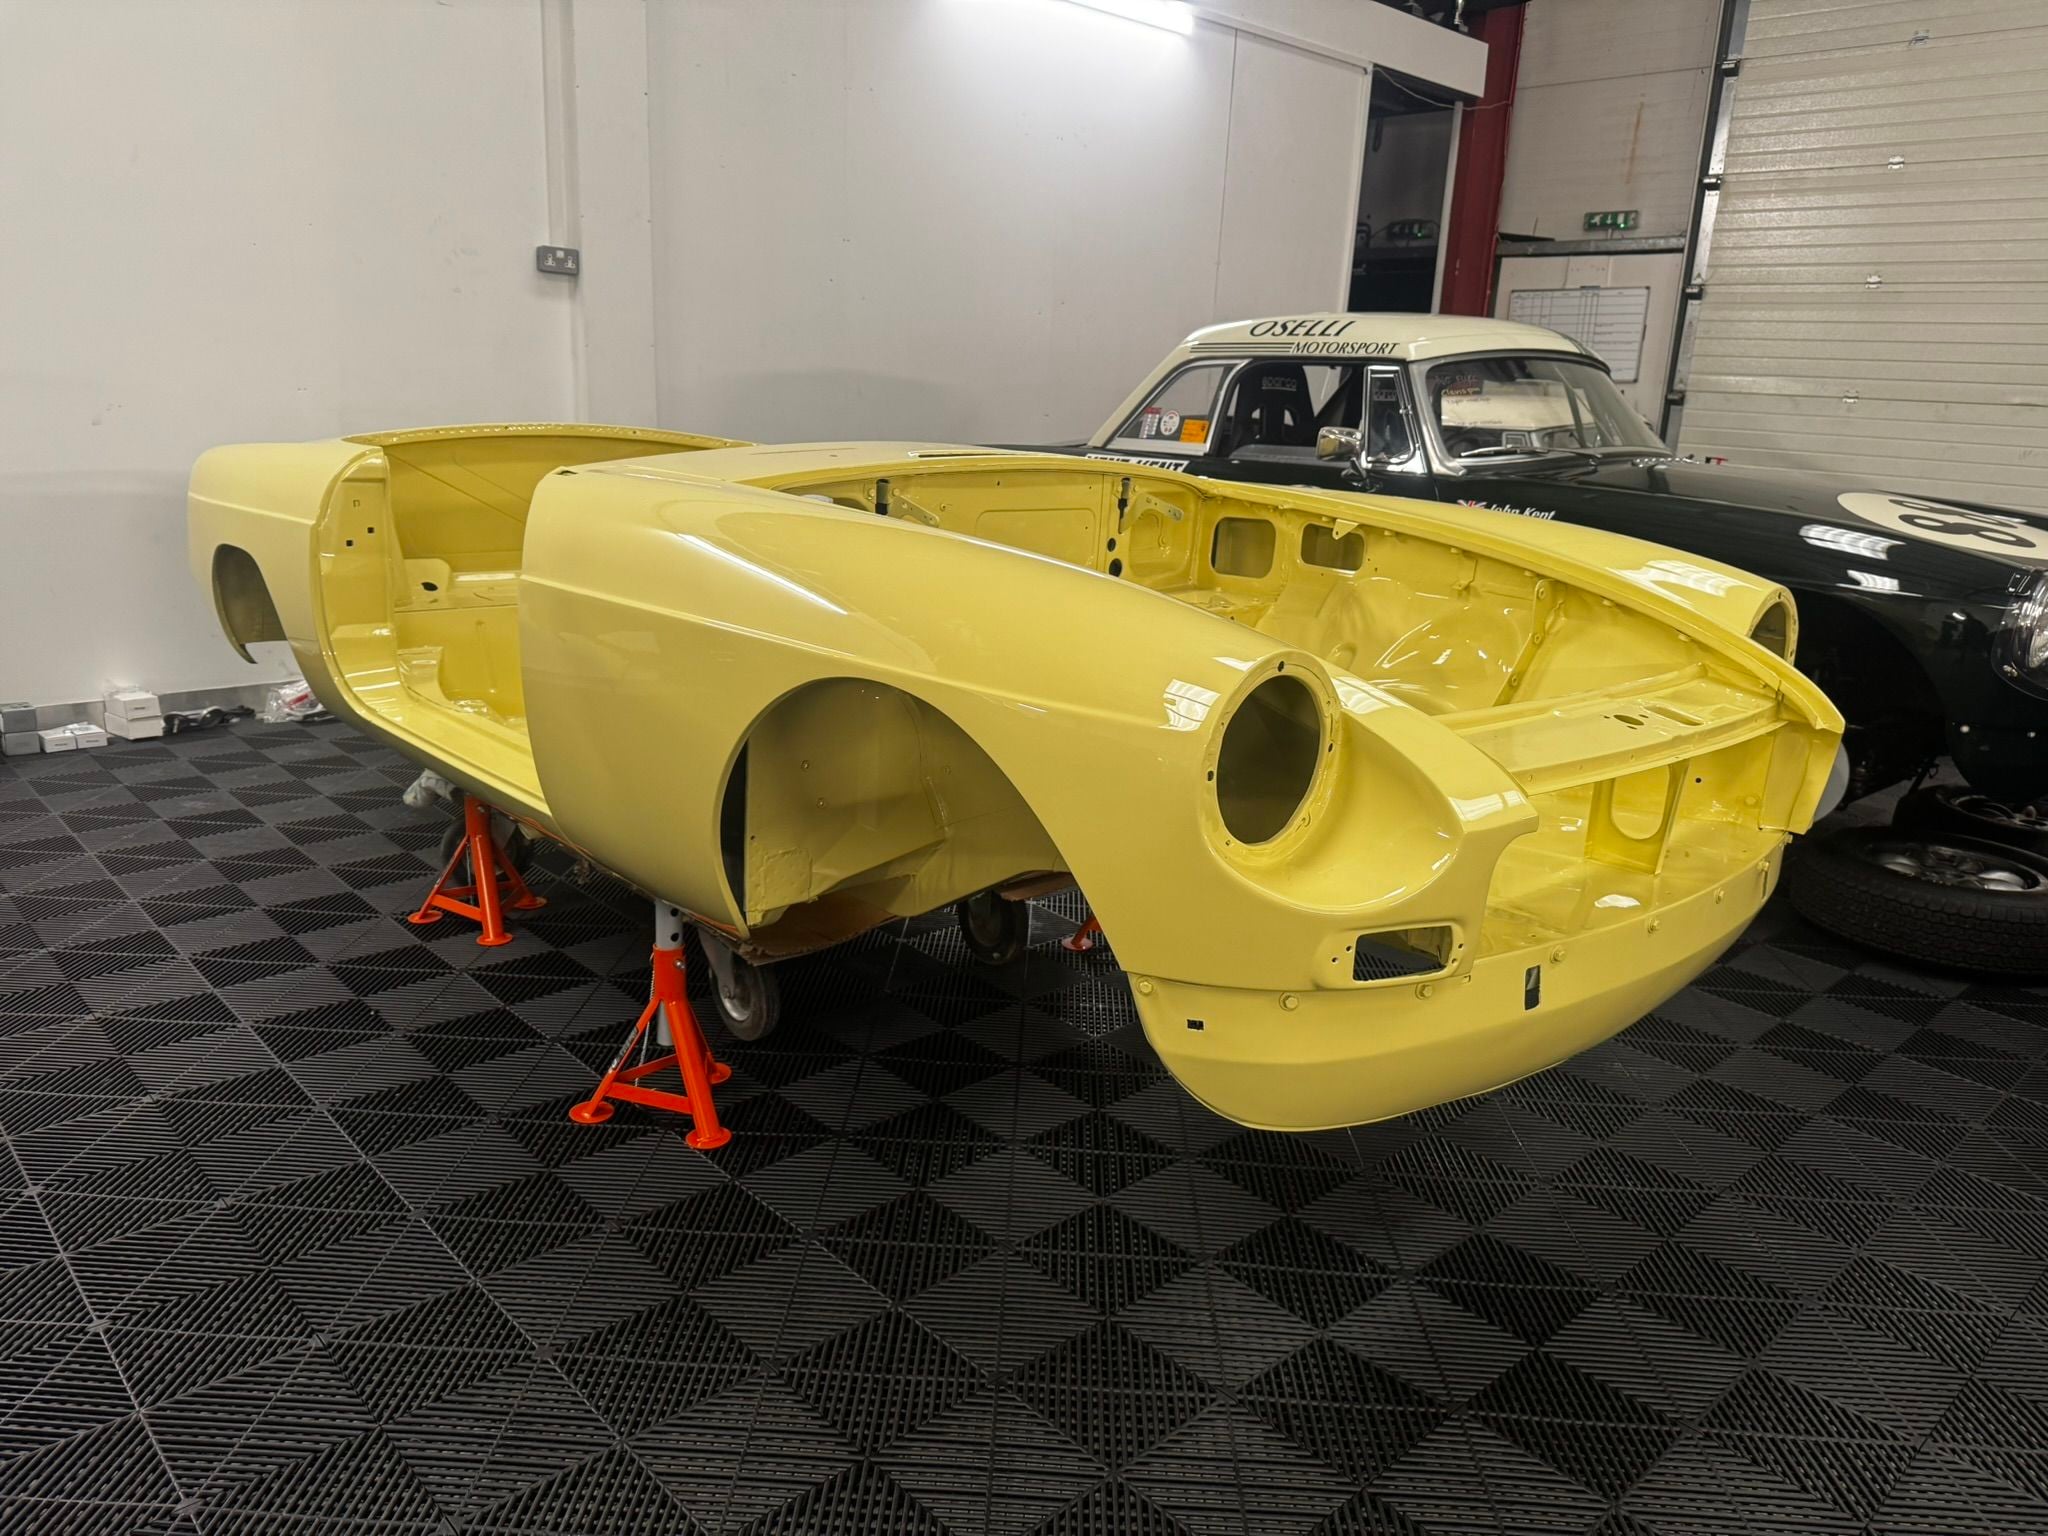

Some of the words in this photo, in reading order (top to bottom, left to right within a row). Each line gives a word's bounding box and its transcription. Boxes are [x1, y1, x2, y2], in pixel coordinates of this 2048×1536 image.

[1249, 319, 1356, 337] OSELLI
[1292, 341, 1400, 355] MOTORSPORT
[1490, 503, 1520, 514] John
[1523, 507, 1556, 520] Kent
